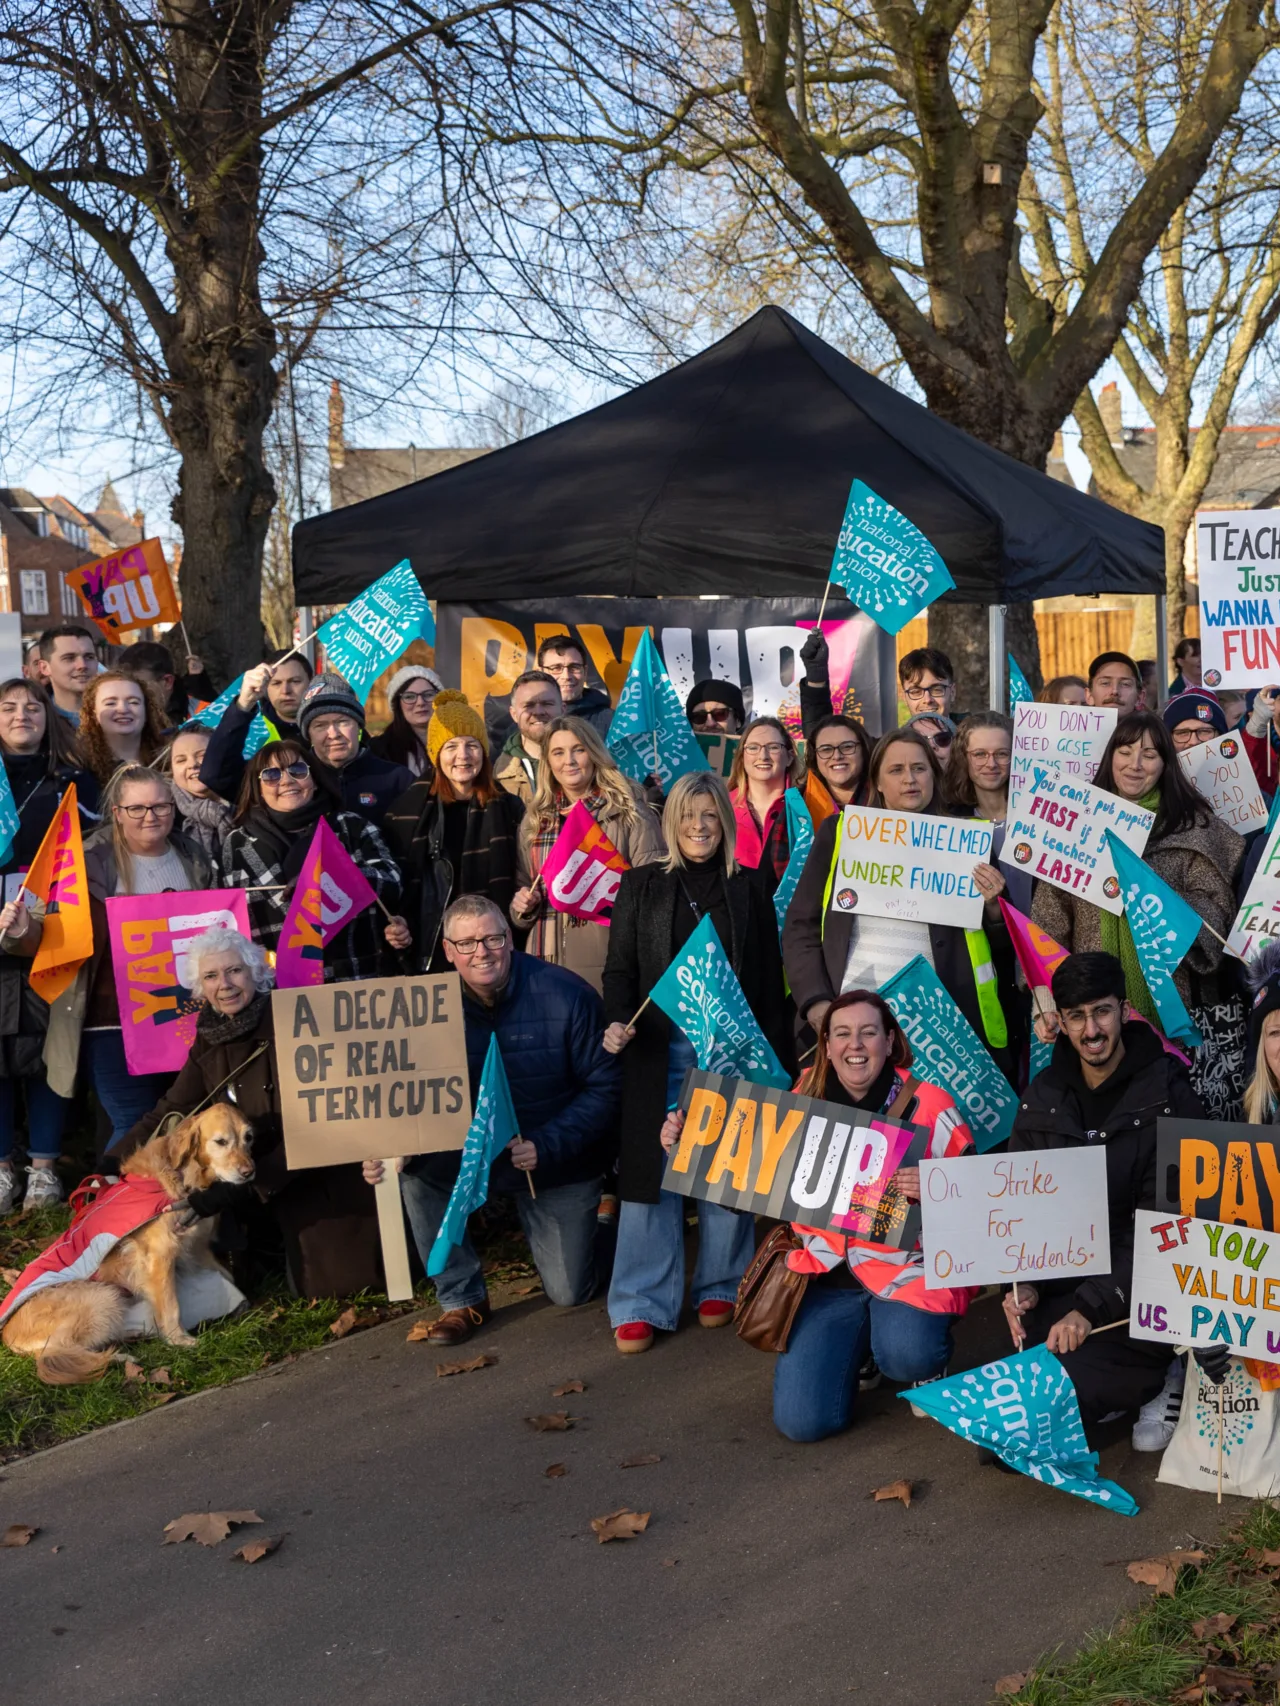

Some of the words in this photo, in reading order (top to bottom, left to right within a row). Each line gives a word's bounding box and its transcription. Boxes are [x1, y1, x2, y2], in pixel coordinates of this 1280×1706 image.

[856, 518, 918, 559] national
[371, 588, 406, 618] national
[1203, 598, 1274, 626] WANNA
[344, 627, 373, 657] union
[1018, 708, 1047, 729] YOU
[1060, 711, 1104, 732] DON'T
[1015, 736, 1049, 751] NEED
[1057, 738, 1092, 756] GCSE
[1205, 745, 1216, 760] A
[1066, 761, 1080, 773] TO
[1208, 761, 1239, 787] YOU
[1029, 767, 1055, 795] You
[1060, 785, 1091, 805] can't
[1093, 800, 1114, 815] put
[1029, 797, 1079, 831] FIRST
[1080, 824, 1092, 845] if
[1011, 821, 1036, 839] put
[1043, 830, 1097, 868] teachers
[910, 867, 982, 898] FUNDED
[1036, 853, 1092, 893] LAST!
[885, 899, 900, 909] PAY
[293, 994, 320, 1038] A
[334, 984, 448, 1032] DECADE
[294, 1043, 334, 1083] OF
[347, 1038, 416, 1077] REAL
[927, 1013, 989, 1083] national
[298, 1084, 381, 1122] TERM
[389, 1076, 462, 1117] CUTS
[672, 1088, 804, 1195] PAY
[927, 1166, 963, 1202] On
[987, 1160, 1059, 1197] Strike
[851, 1192, 905, 1221] education
[987, 1208, 1024, 1238] For
[1150, 1216, 1192, 1252] IF
[1203, 1224, 1270, 1271] YOU
[934, 1249, 975, 1279] Our
[1190, 1305, 1256, 1348] PAY
